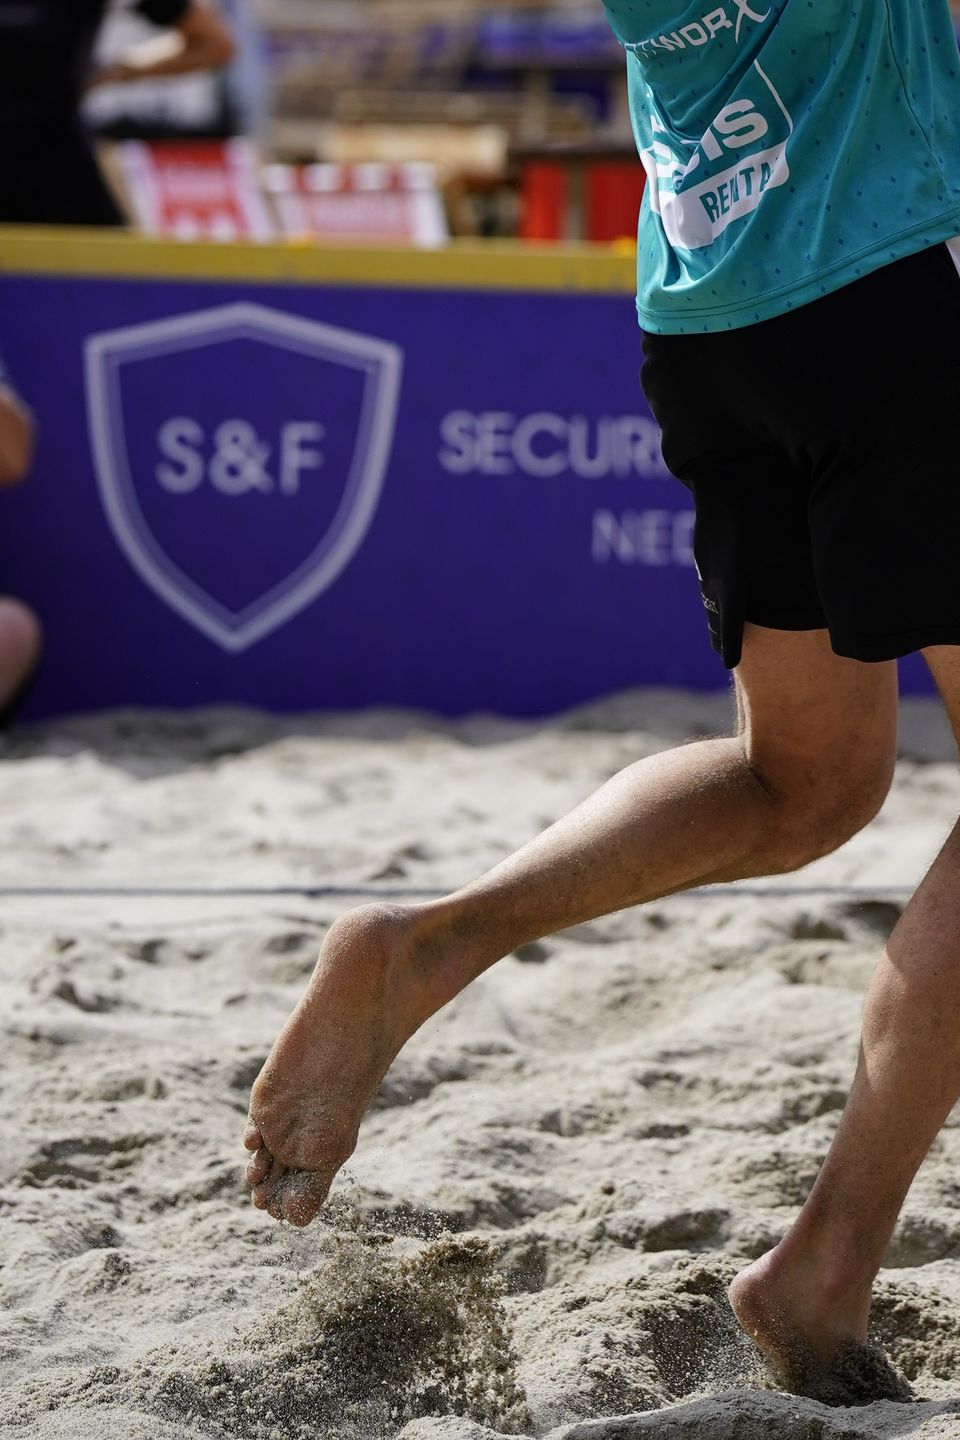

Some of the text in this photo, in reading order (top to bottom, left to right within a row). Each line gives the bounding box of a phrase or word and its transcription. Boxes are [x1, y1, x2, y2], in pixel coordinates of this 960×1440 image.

[699, 156, 779, 224] RENTA
[155, 417, 325, 496] S&F
[438, 410, 670, 478] SECUR
